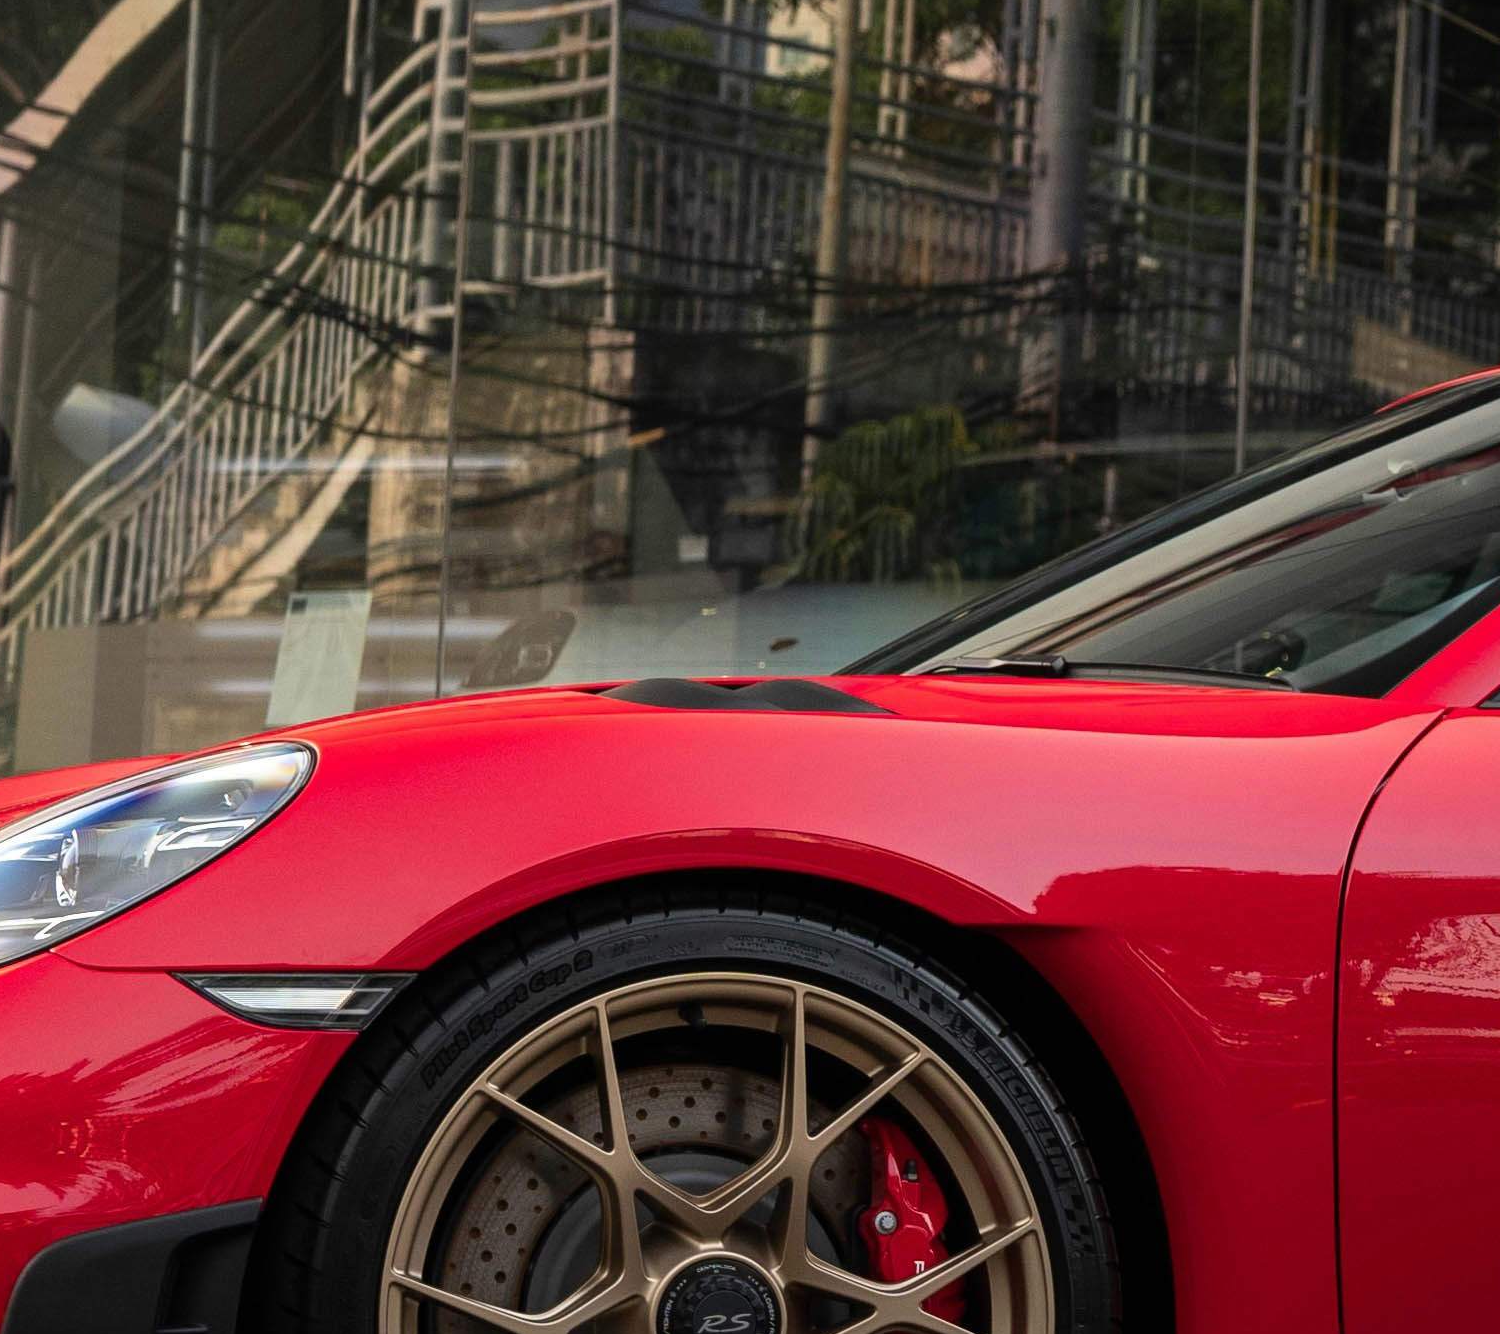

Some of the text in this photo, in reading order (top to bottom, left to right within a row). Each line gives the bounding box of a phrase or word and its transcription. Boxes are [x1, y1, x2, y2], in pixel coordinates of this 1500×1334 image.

[420, 1030, 470, 1089] Pilot
[467, 983, 530, 1040] Sport
[528, 962, 573, 993] Cup
[573, 949, 594, 973] 2
[980, 1043, 1072, 1181] MICHELIN
[697, 1313, 752, 1334] RS
